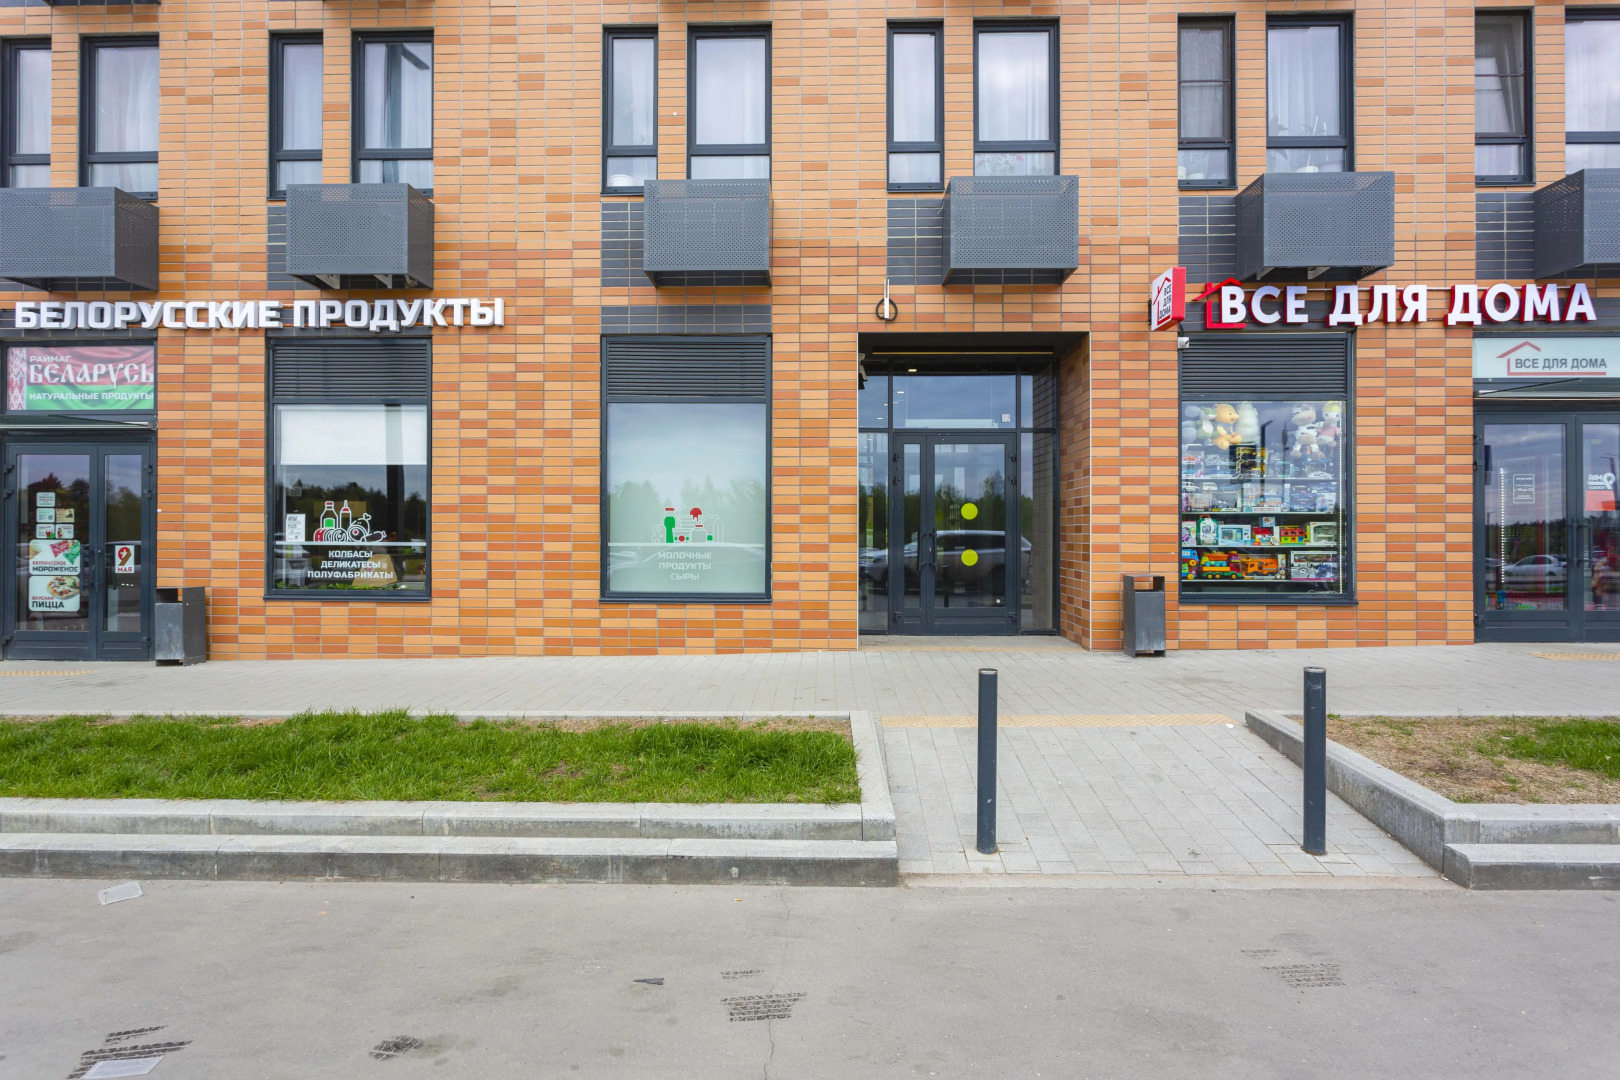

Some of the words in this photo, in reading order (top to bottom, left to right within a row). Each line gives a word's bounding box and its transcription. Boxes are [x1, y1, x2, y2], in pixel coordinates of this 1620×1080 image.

[1220, 285, 1309, 324] ВСЕ
[1327, 285, 1427, 327] ДЛЯ
[1445, 283, 1598, 327] ДОМА
[15, 301, 284, 330] БЕЛОРУССКИЕ
[293, 298, 504, 332] ПРОДУКТЫ
[30, 354, 72, 363] РАЙМАГ
[1515, 358, 1539, 368] ВСЕ
[1542, 358, 1568, 370] ДЛЯ
[1570, 358, 1608, 370] ДОМА
[30, 392, 100, 400] НАТУРАЛЬНЫЕ
[101, 392, 154, 400] ПРОДУКТЫ
[118, 546, 132, 566] 9
[328, 550, 372, 558] КОЛБАСЫ
[658, 552, 712, 560] МОЛОЧНЫЕ
[320, 560, 380, 569] ДЕЛИКАТЕСЫ
[308, 570, 394, 579] ПОЛУФАБРИКАТЫ
[32, 601, 64, 609] ПИЦЦА
